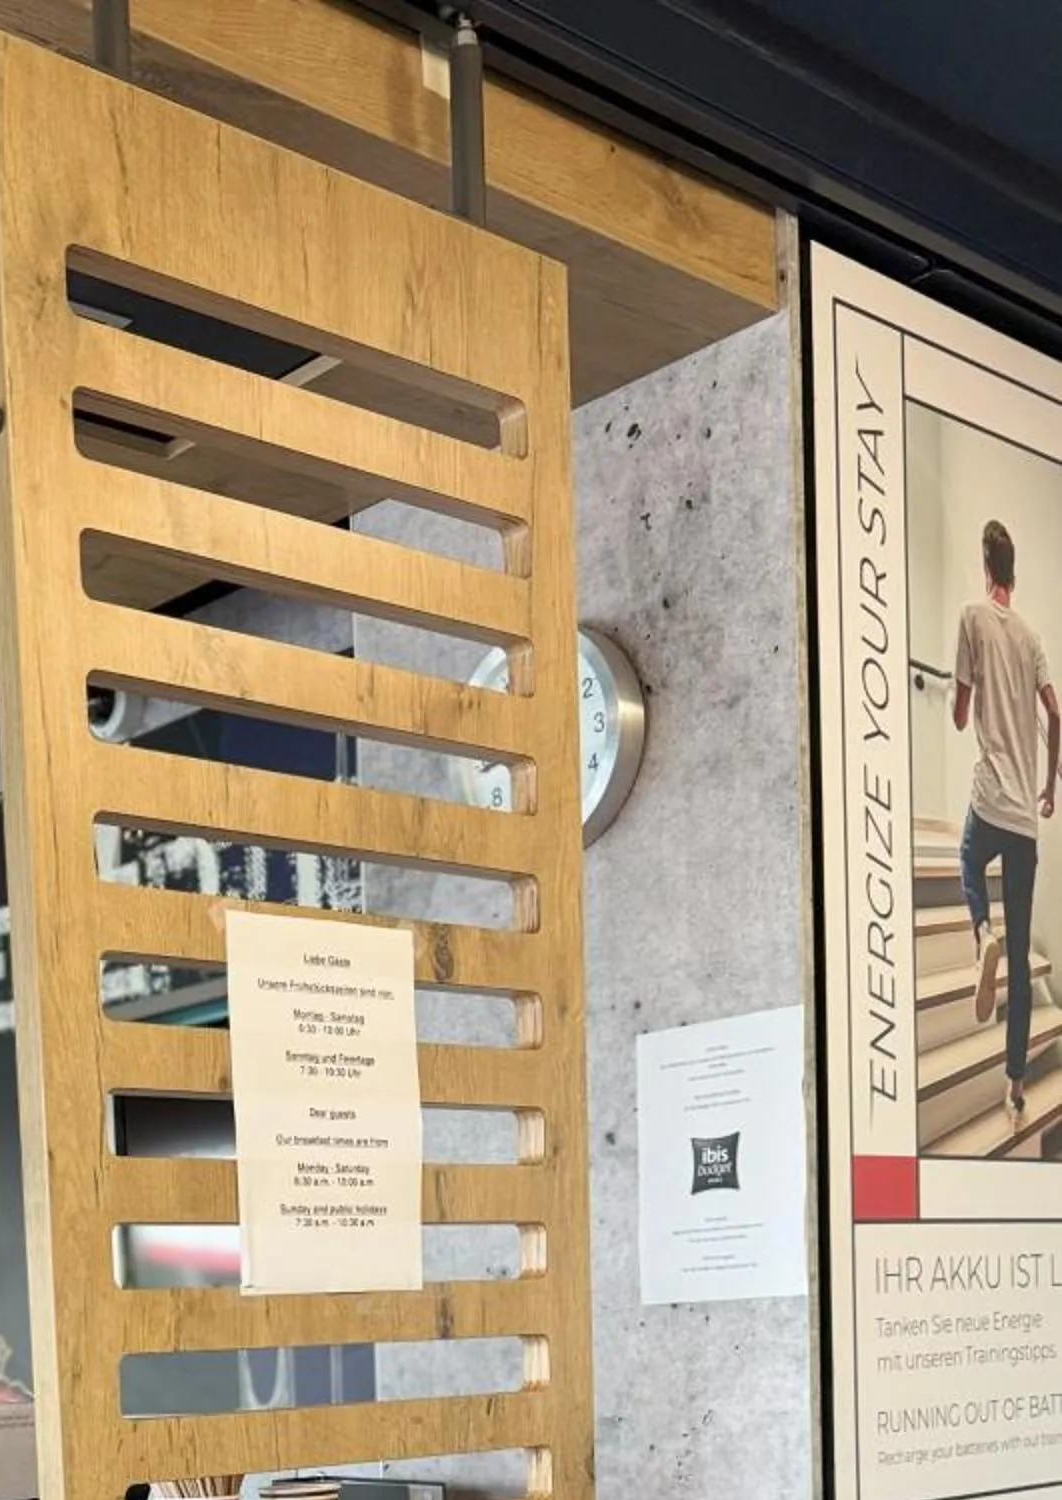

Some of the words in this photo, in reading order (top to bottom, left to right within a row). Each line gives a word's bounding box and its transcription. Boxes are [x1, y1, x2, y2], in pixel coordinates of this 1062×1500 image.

[854, 349, 887, 547] STAY
[860, 556, 891, 742] YOUR
[581, 677, 594, 698] 2
[593, 711, 605, 733] 3
[587, 752, 599, 771] 4
[863, 763, 898, 1132] ENERGIZE
[701, 1144, 729, 1165] ibis
[875, 1256, 923, 1294] IHR
[930, 1255, 1001, 1291] AKKU
[1009, 1253, 1044, 1289] IST
[875, 1317, 929, 1338] Tanken
[931, 1314, 953, 1335] Sie
[955, 1316, 989, 1333] neue
[993, 1311, 1043, 1333] Energie
[876, 1354, 903, 1373] mit
[905, 1350, 962, 1371] unseren
[877, 1402, 961, 1435] RUNNING
[964, 1400, 998, 1426] OUT
[1002, 1397, 1025, 1421] OF
